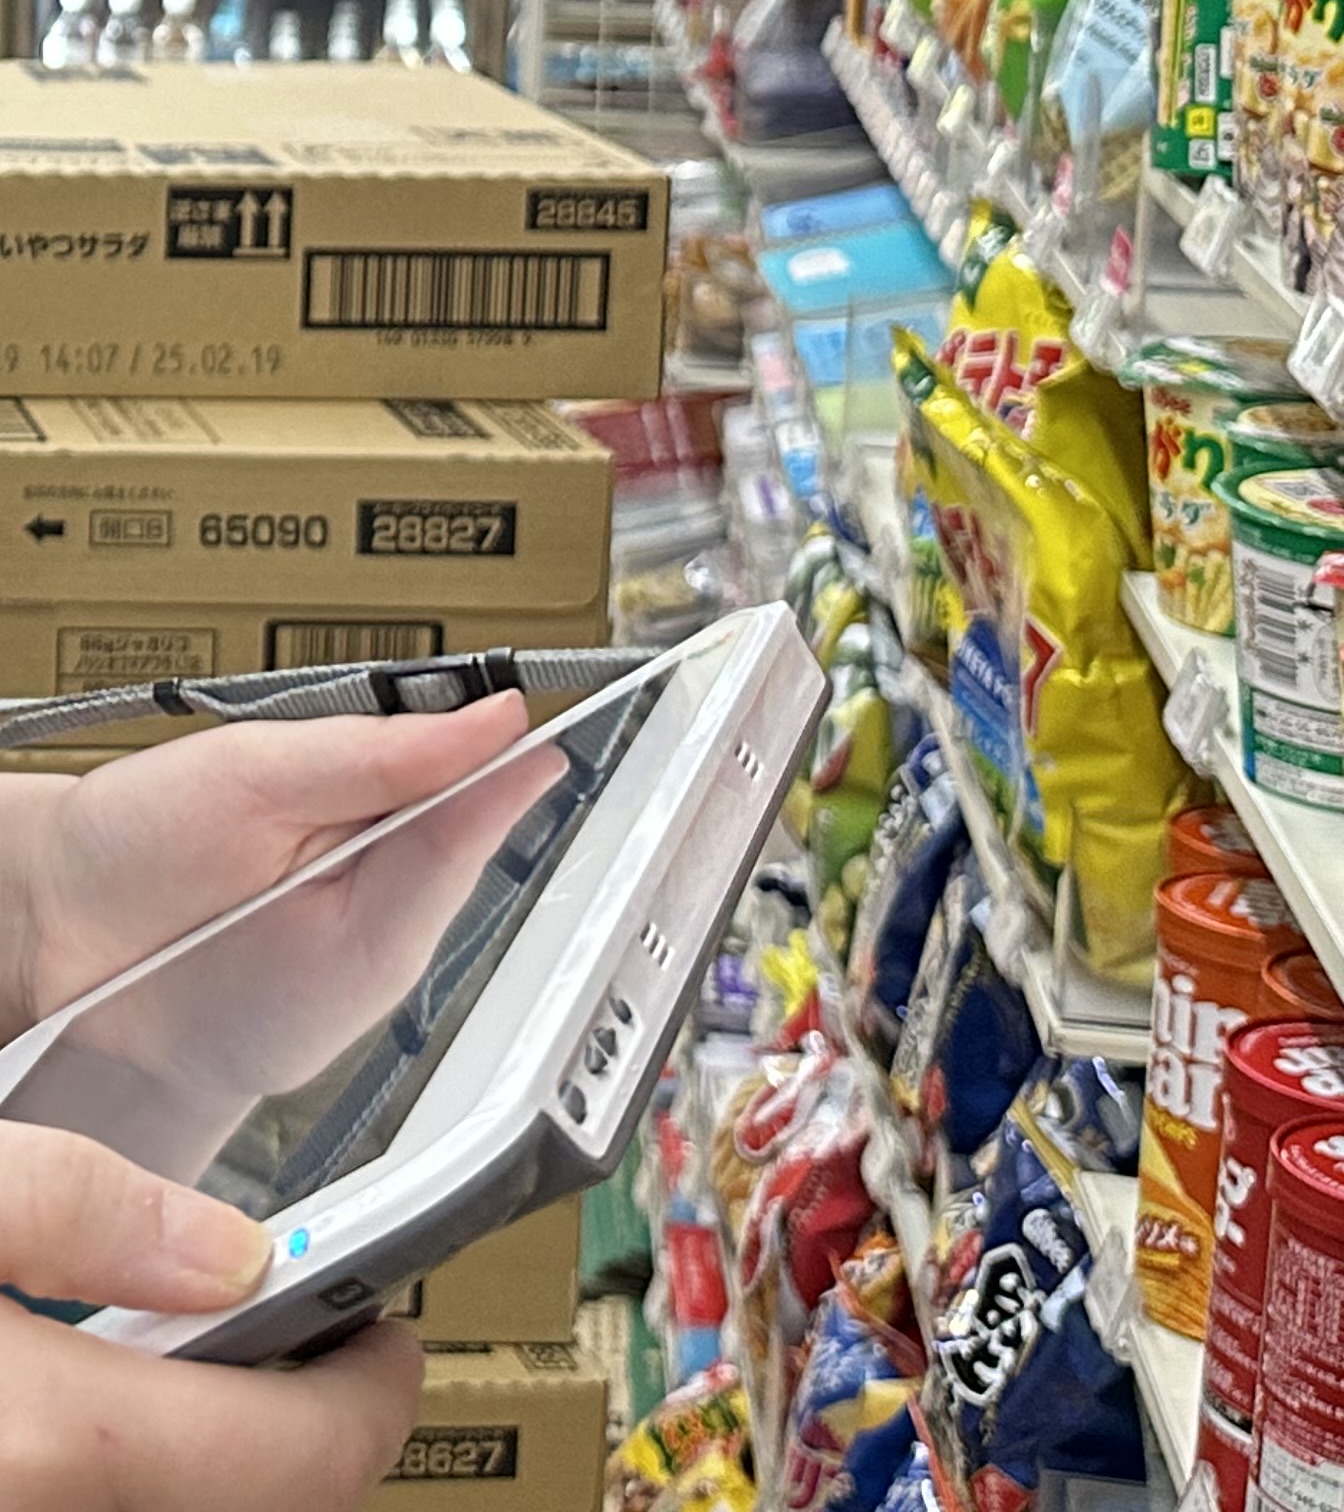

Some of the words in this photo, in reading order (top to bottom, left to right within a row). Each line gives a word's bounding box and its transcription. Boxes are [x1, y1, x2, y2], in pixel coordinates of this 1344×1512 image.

[199, 514, 330, 549] 65090
[371, 515, 502, 551] 28827
[386, 1440, 505, 1476] 8627
